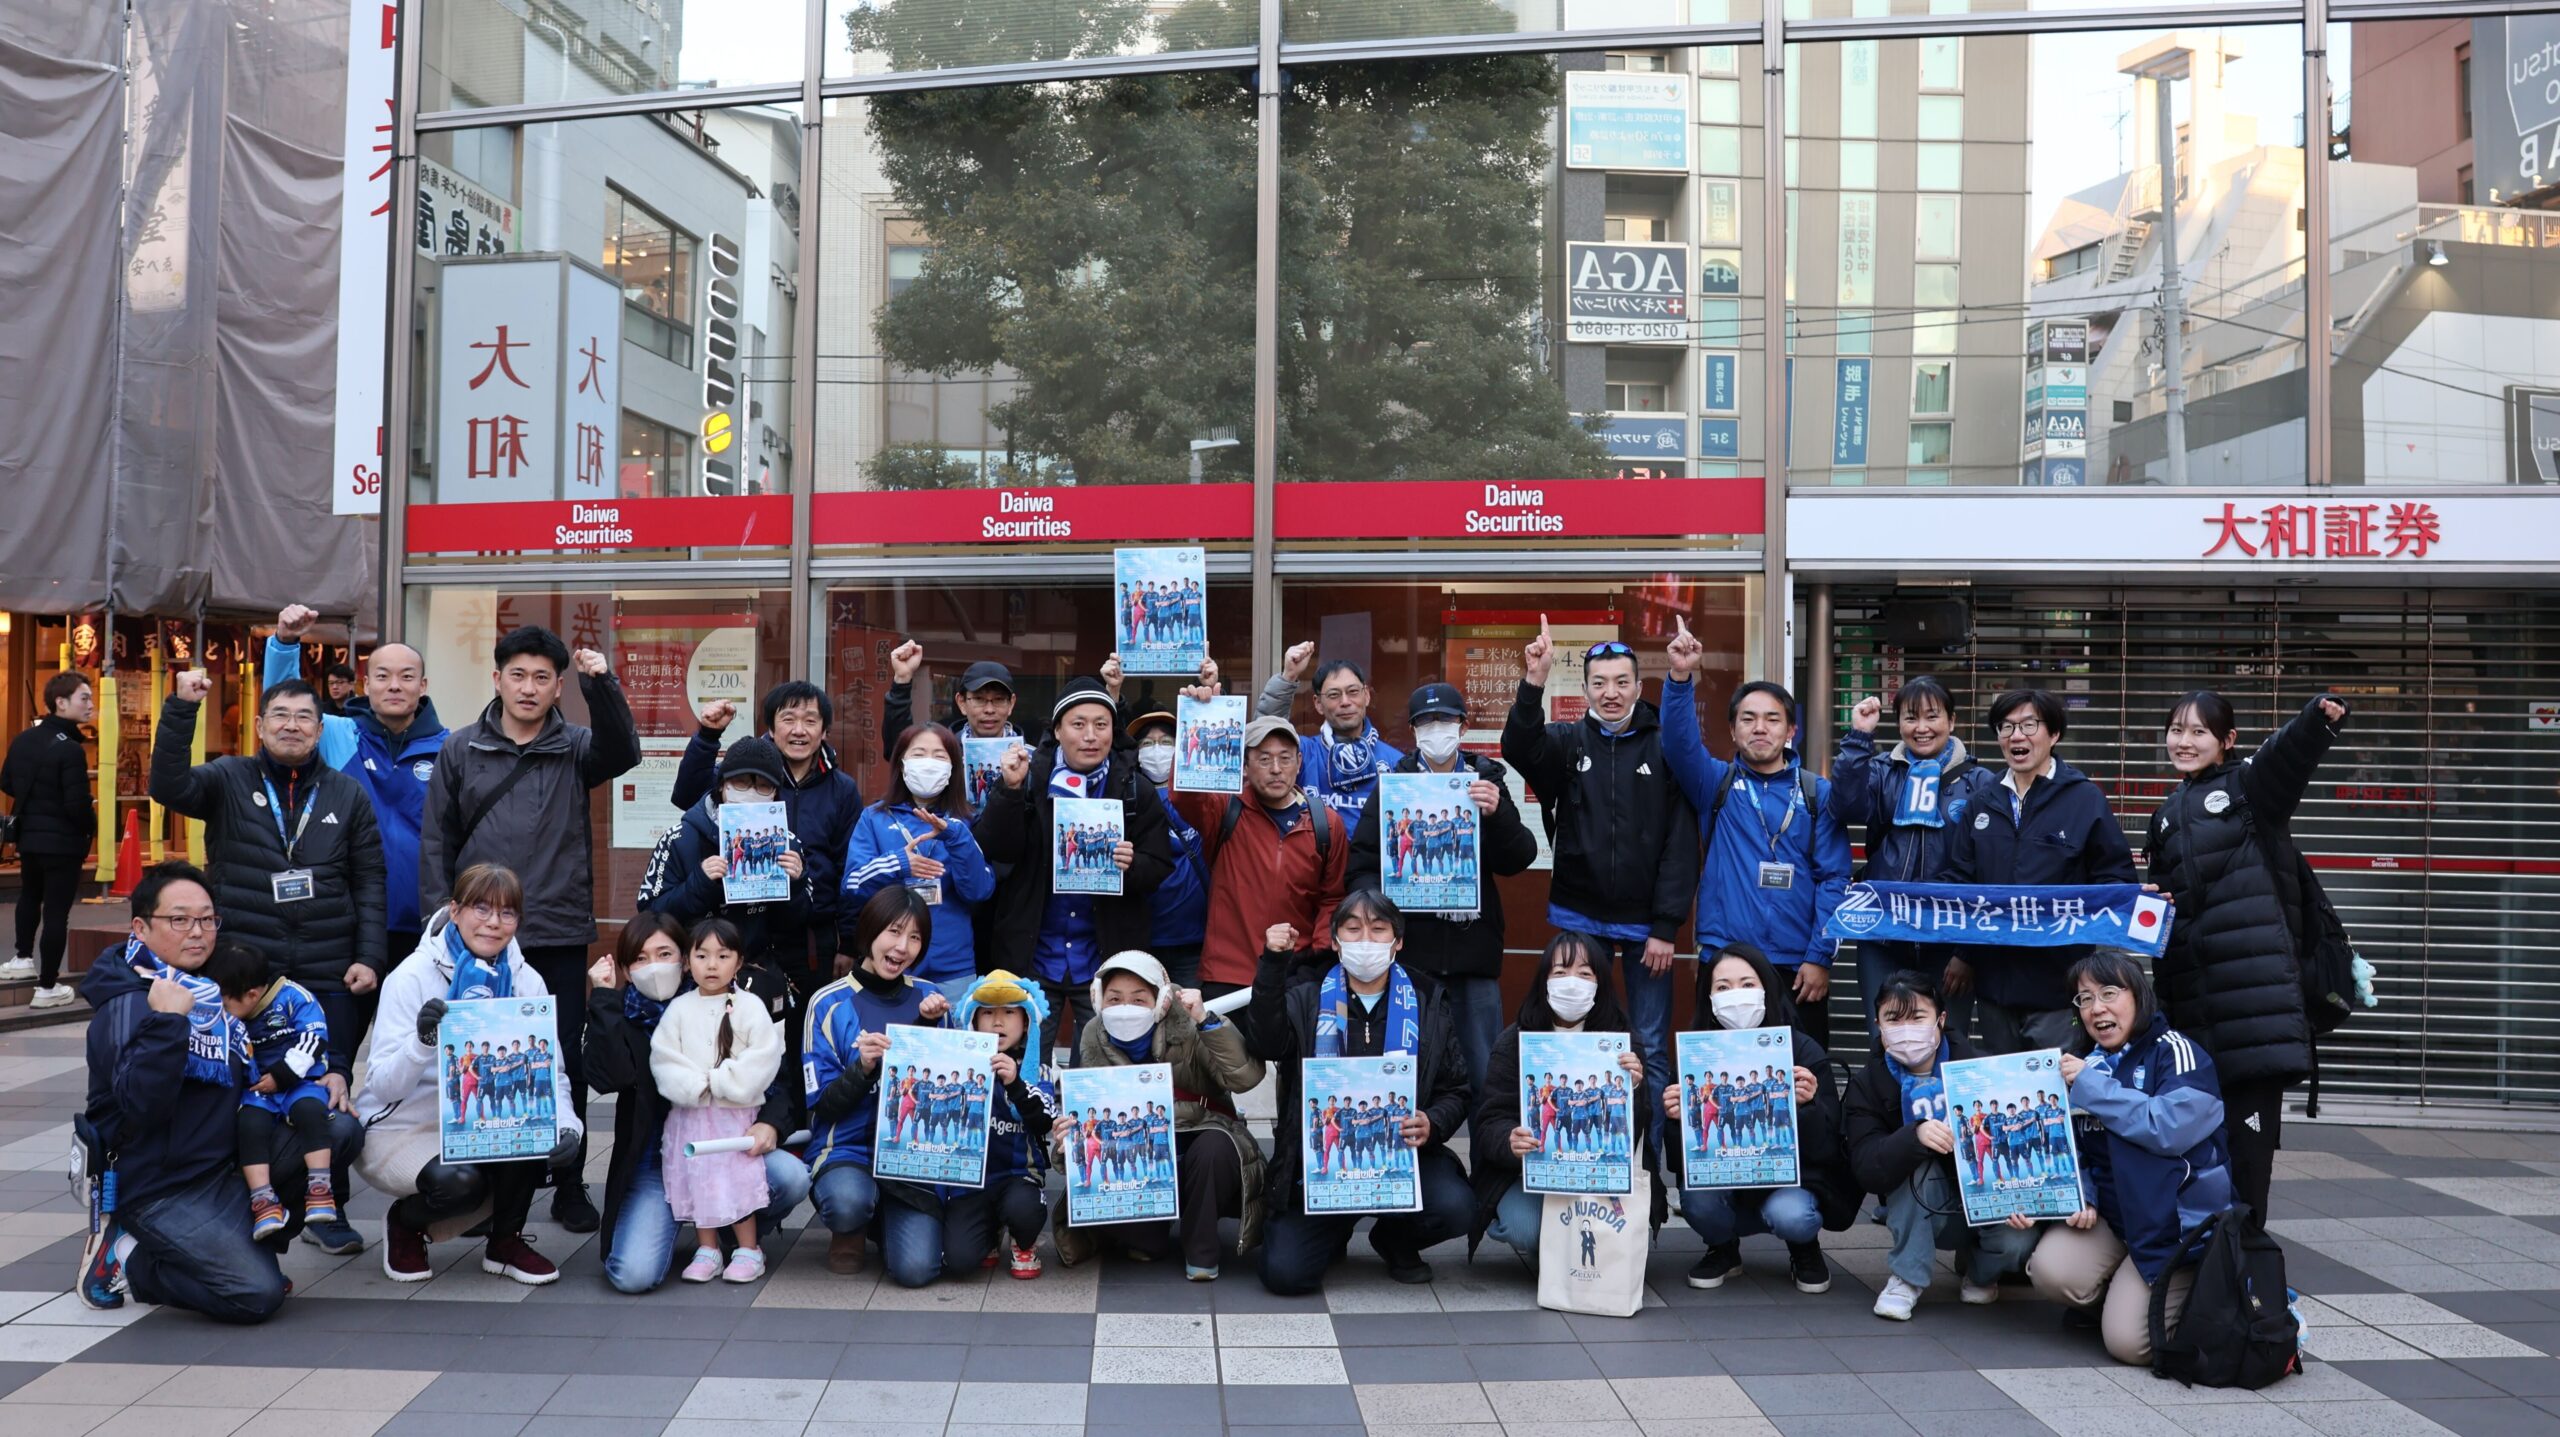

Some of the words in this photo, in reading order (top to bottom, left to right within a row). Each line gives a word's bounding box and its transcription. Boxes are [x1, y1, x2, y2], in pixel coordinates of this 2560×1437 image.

[1000, 492, 1054, 514] Daiwa
[1484, 485, 1544, 507] Daiwa
[572, 504, 619, 524] Daiwa
[1465, 510, 1564, 533] Securities
[555, 525, 633, 545] Securities
[982, 515, 1072, 540] Securities
[2203, 502, 2441, 558] 大和証券
[1488, 647, 1521, 660] 米ドル
[628, 664, 682, 677] 円定期預金
[1465, 664, 1521, 677] 定期預金
[628, 679, 681, 689] キャンペーン
[1910, 776, 1940, 813] 16
[652, 861, 665, 897] deportes
[661, 849, 670, 861] de
[1889, 892, 2122, 936] 町田を世界へ
[990, 1116, 1025, 1136] Agent
[1560, 1205, 1573, 1227] GO
[1574, 1200, 1627, 1234] KURODA
[1569, 1267, 1602, 1279] ZELVIA
